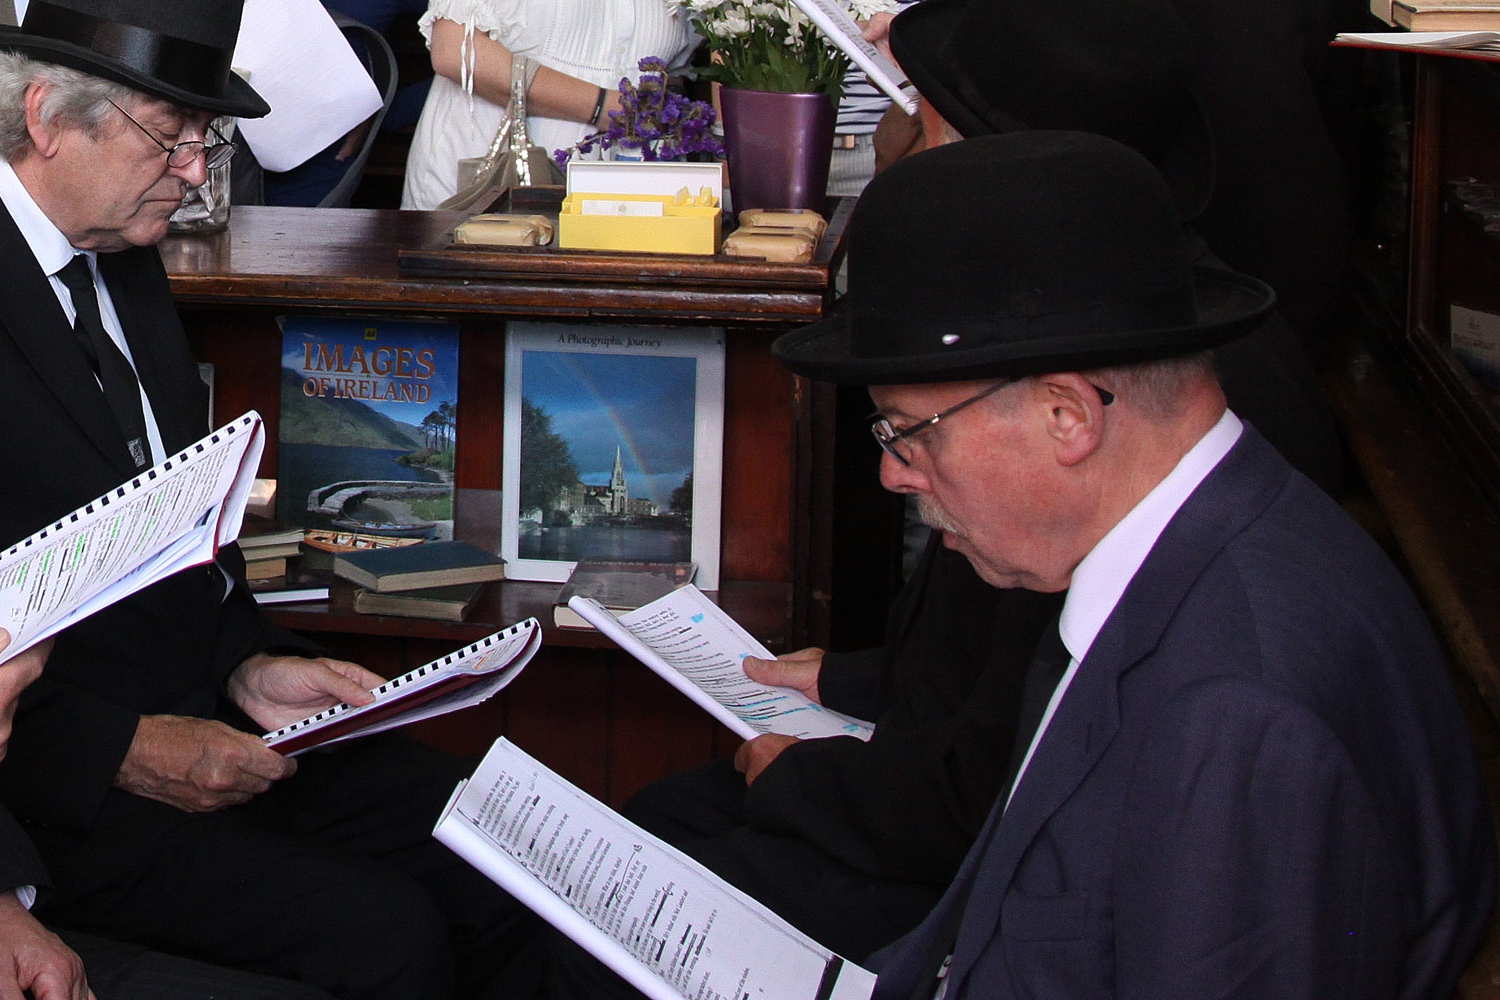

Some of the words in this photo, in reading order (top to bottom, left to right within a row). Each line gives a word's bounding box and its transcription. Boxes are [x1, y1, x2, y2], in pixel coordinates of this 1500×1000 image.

[558, 333, 565, 344] A
[566, 334, 625, 348] Photographic
[626, 337, 662, 350] Journey
[303, 342, 436, 380] IMAGES
[303, 376, 331, 398] OF
[334, 378, 433, 404] IRELAND
